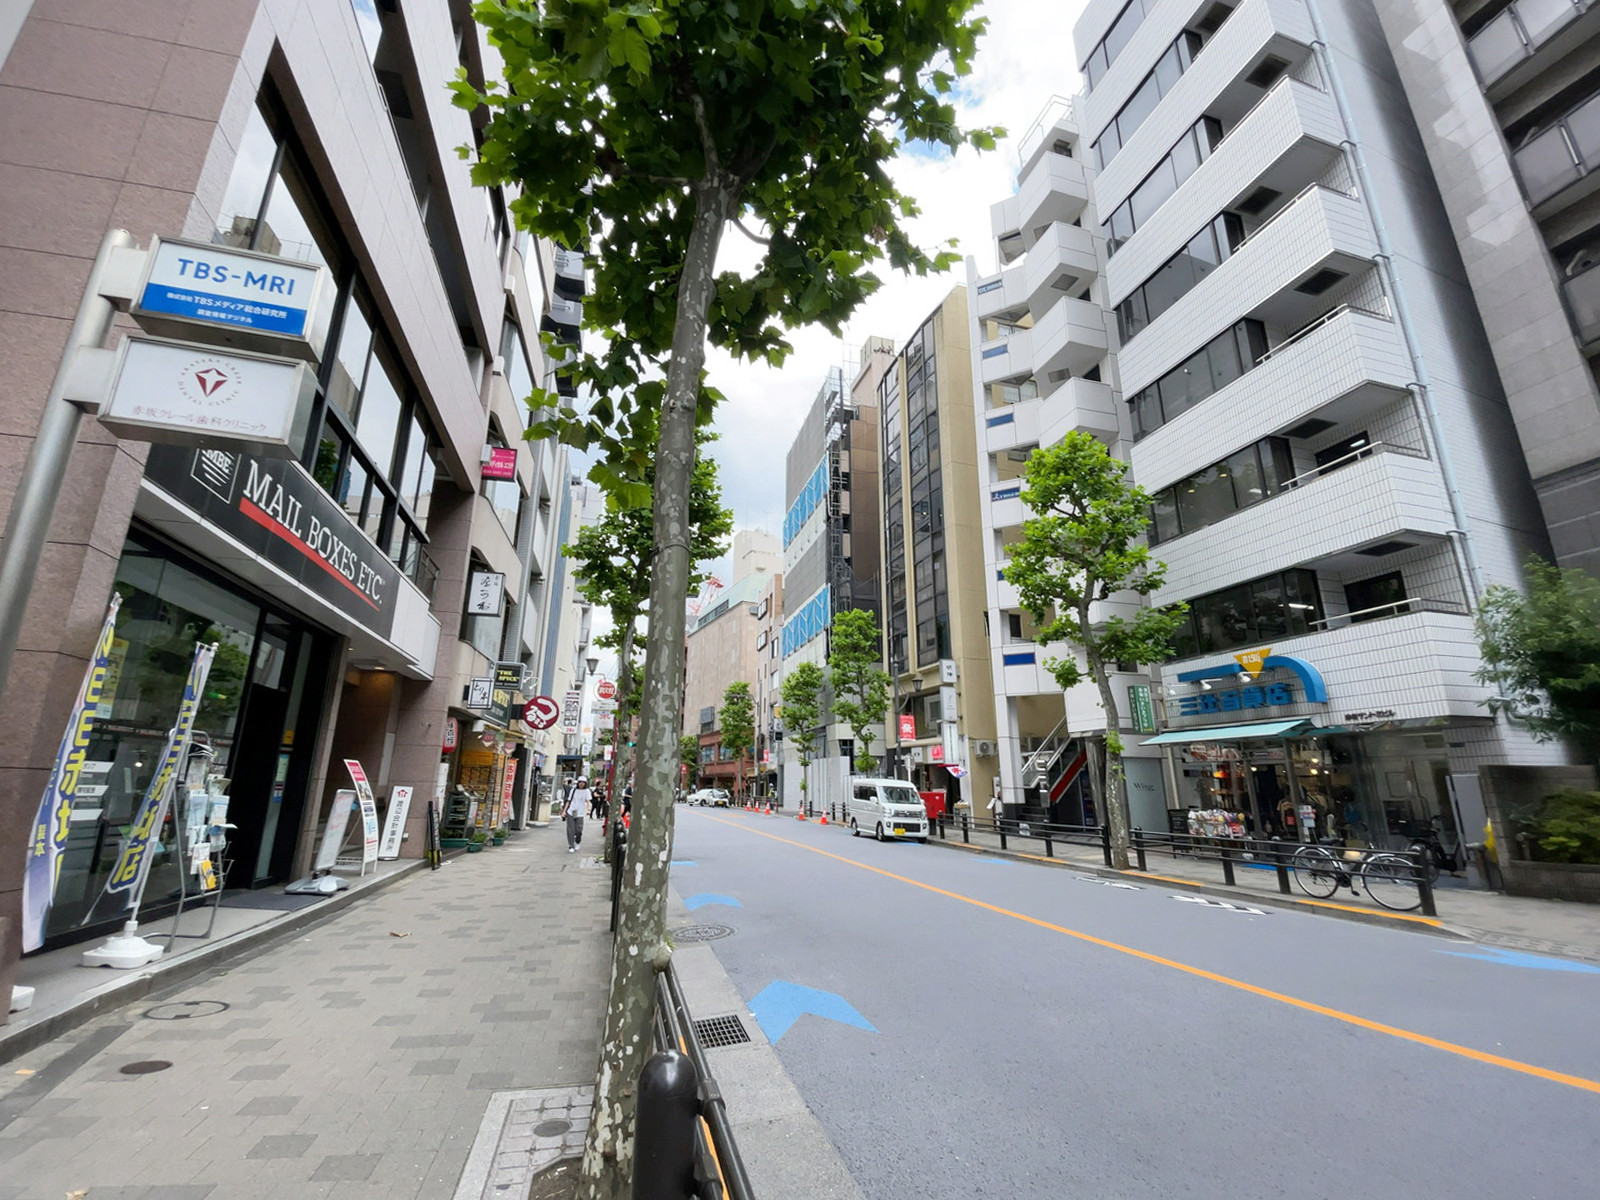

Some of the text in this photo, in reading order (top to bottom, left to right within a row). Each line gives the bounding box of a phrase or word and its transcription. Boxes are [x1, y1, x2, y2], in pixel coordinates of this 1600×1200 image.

[178, 258, 295, 295] TBS-MRI
[132, 405, 268, 432] 赤坂クレール歯科クリニック
[242, 459, 303, 538] MAIL
[306, 515, 358, 581] BOXES
